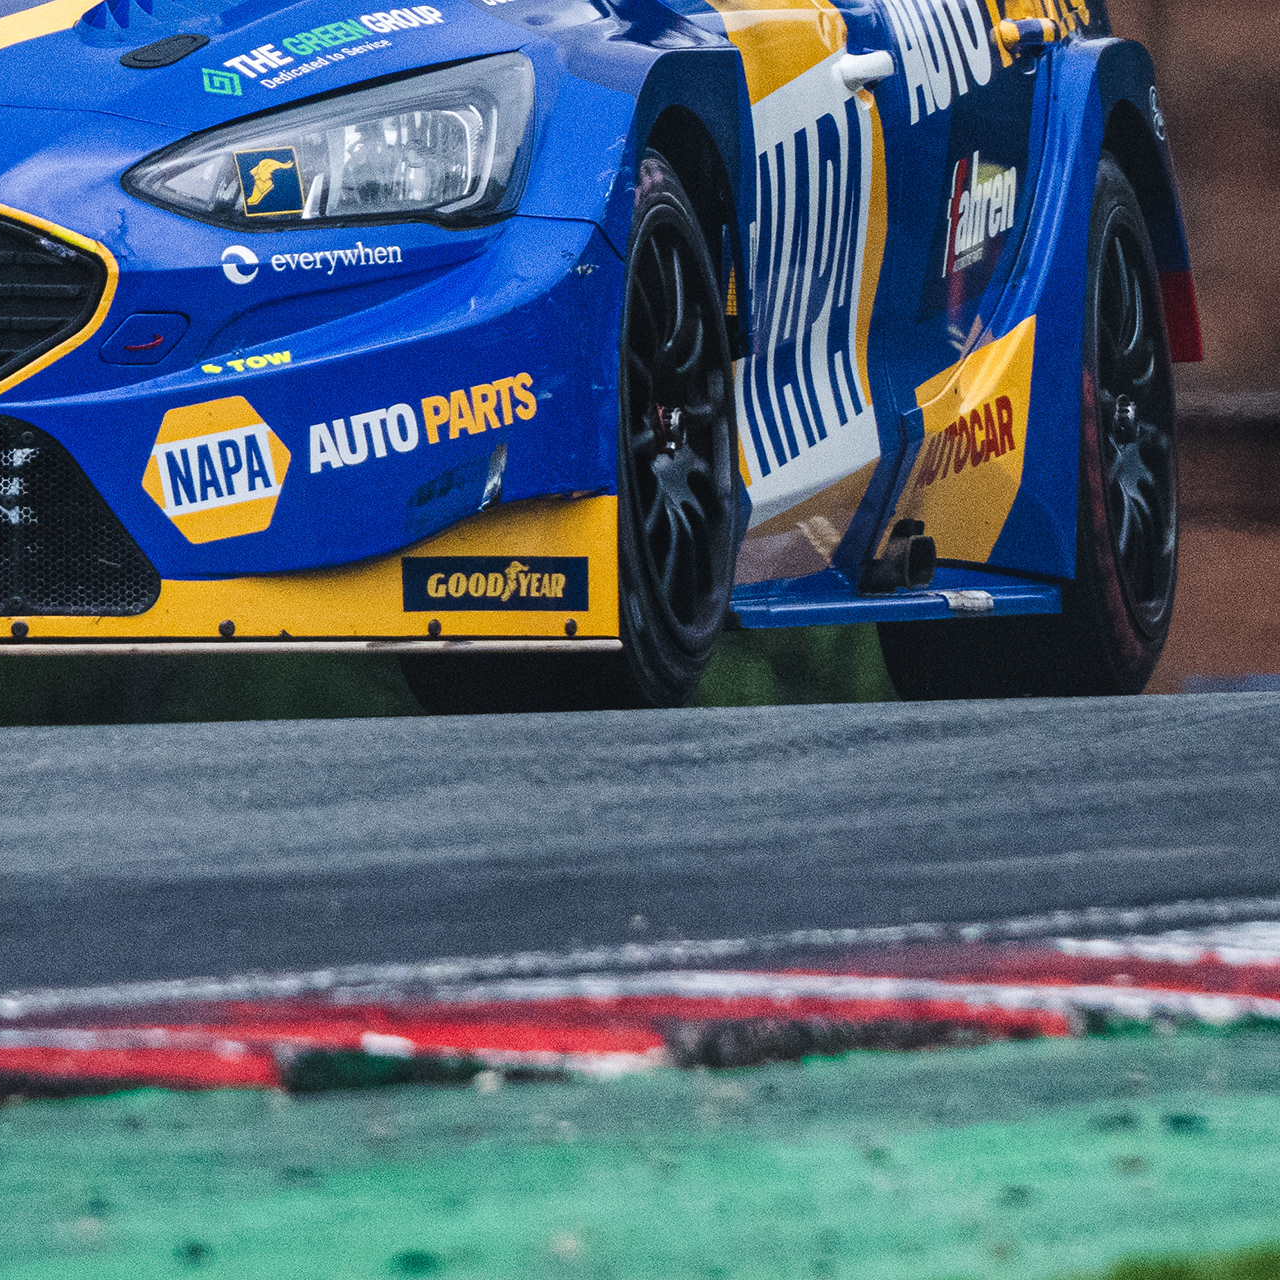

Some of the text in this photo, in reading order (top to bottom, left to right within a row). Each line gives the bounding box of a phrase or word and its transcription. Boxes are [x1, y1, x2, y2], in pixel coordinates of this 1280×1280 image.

[223, 4, 446, 79] THE GREEN GROUP
[259, 37, 393, 90] Dedicated to Service
[270, 241, 403, 274] everywhen
[226, 350, 292, 373] TOW
[309, 372, 538, 474] AUTO PARTS
[164, 433, 273, 508] NAPA
[427, 566, 566, 602] GOODYEAR
